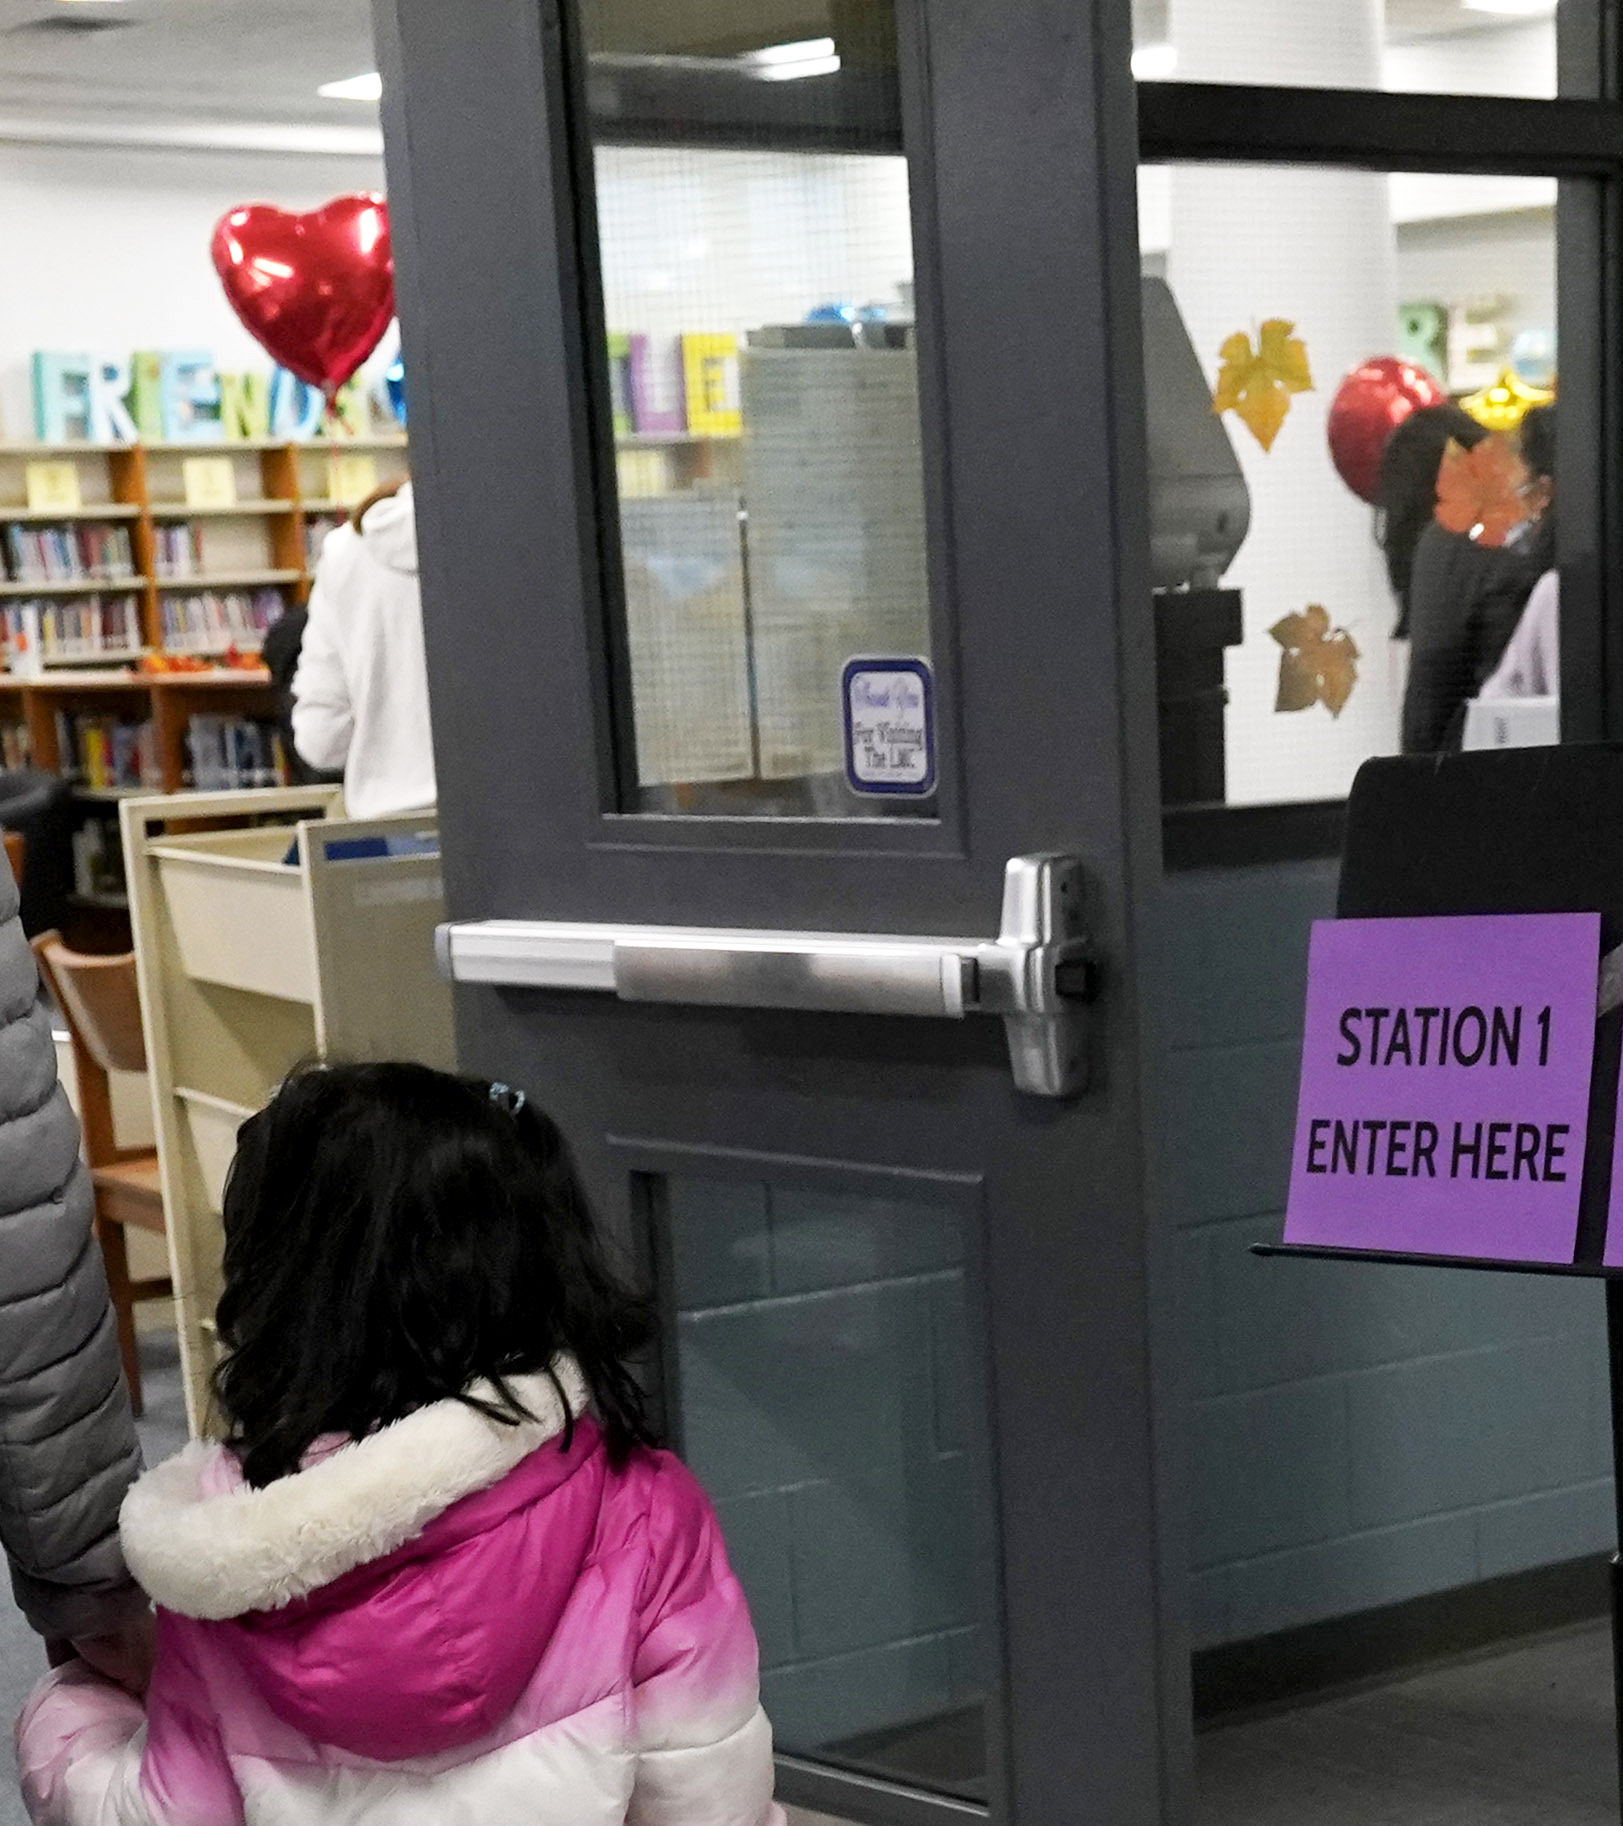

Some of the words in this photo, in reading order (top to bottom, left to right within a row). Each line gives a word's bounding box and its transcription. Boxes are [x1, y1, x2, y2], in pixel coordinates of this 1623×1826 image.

[1336, 1005, 1523, 1067] STATION
[1537, 1005, 1551, 1067] 1
[1306, 1119, 1439, 1178] ENTER
[1450, 1121, 1570, 1182] HERE
